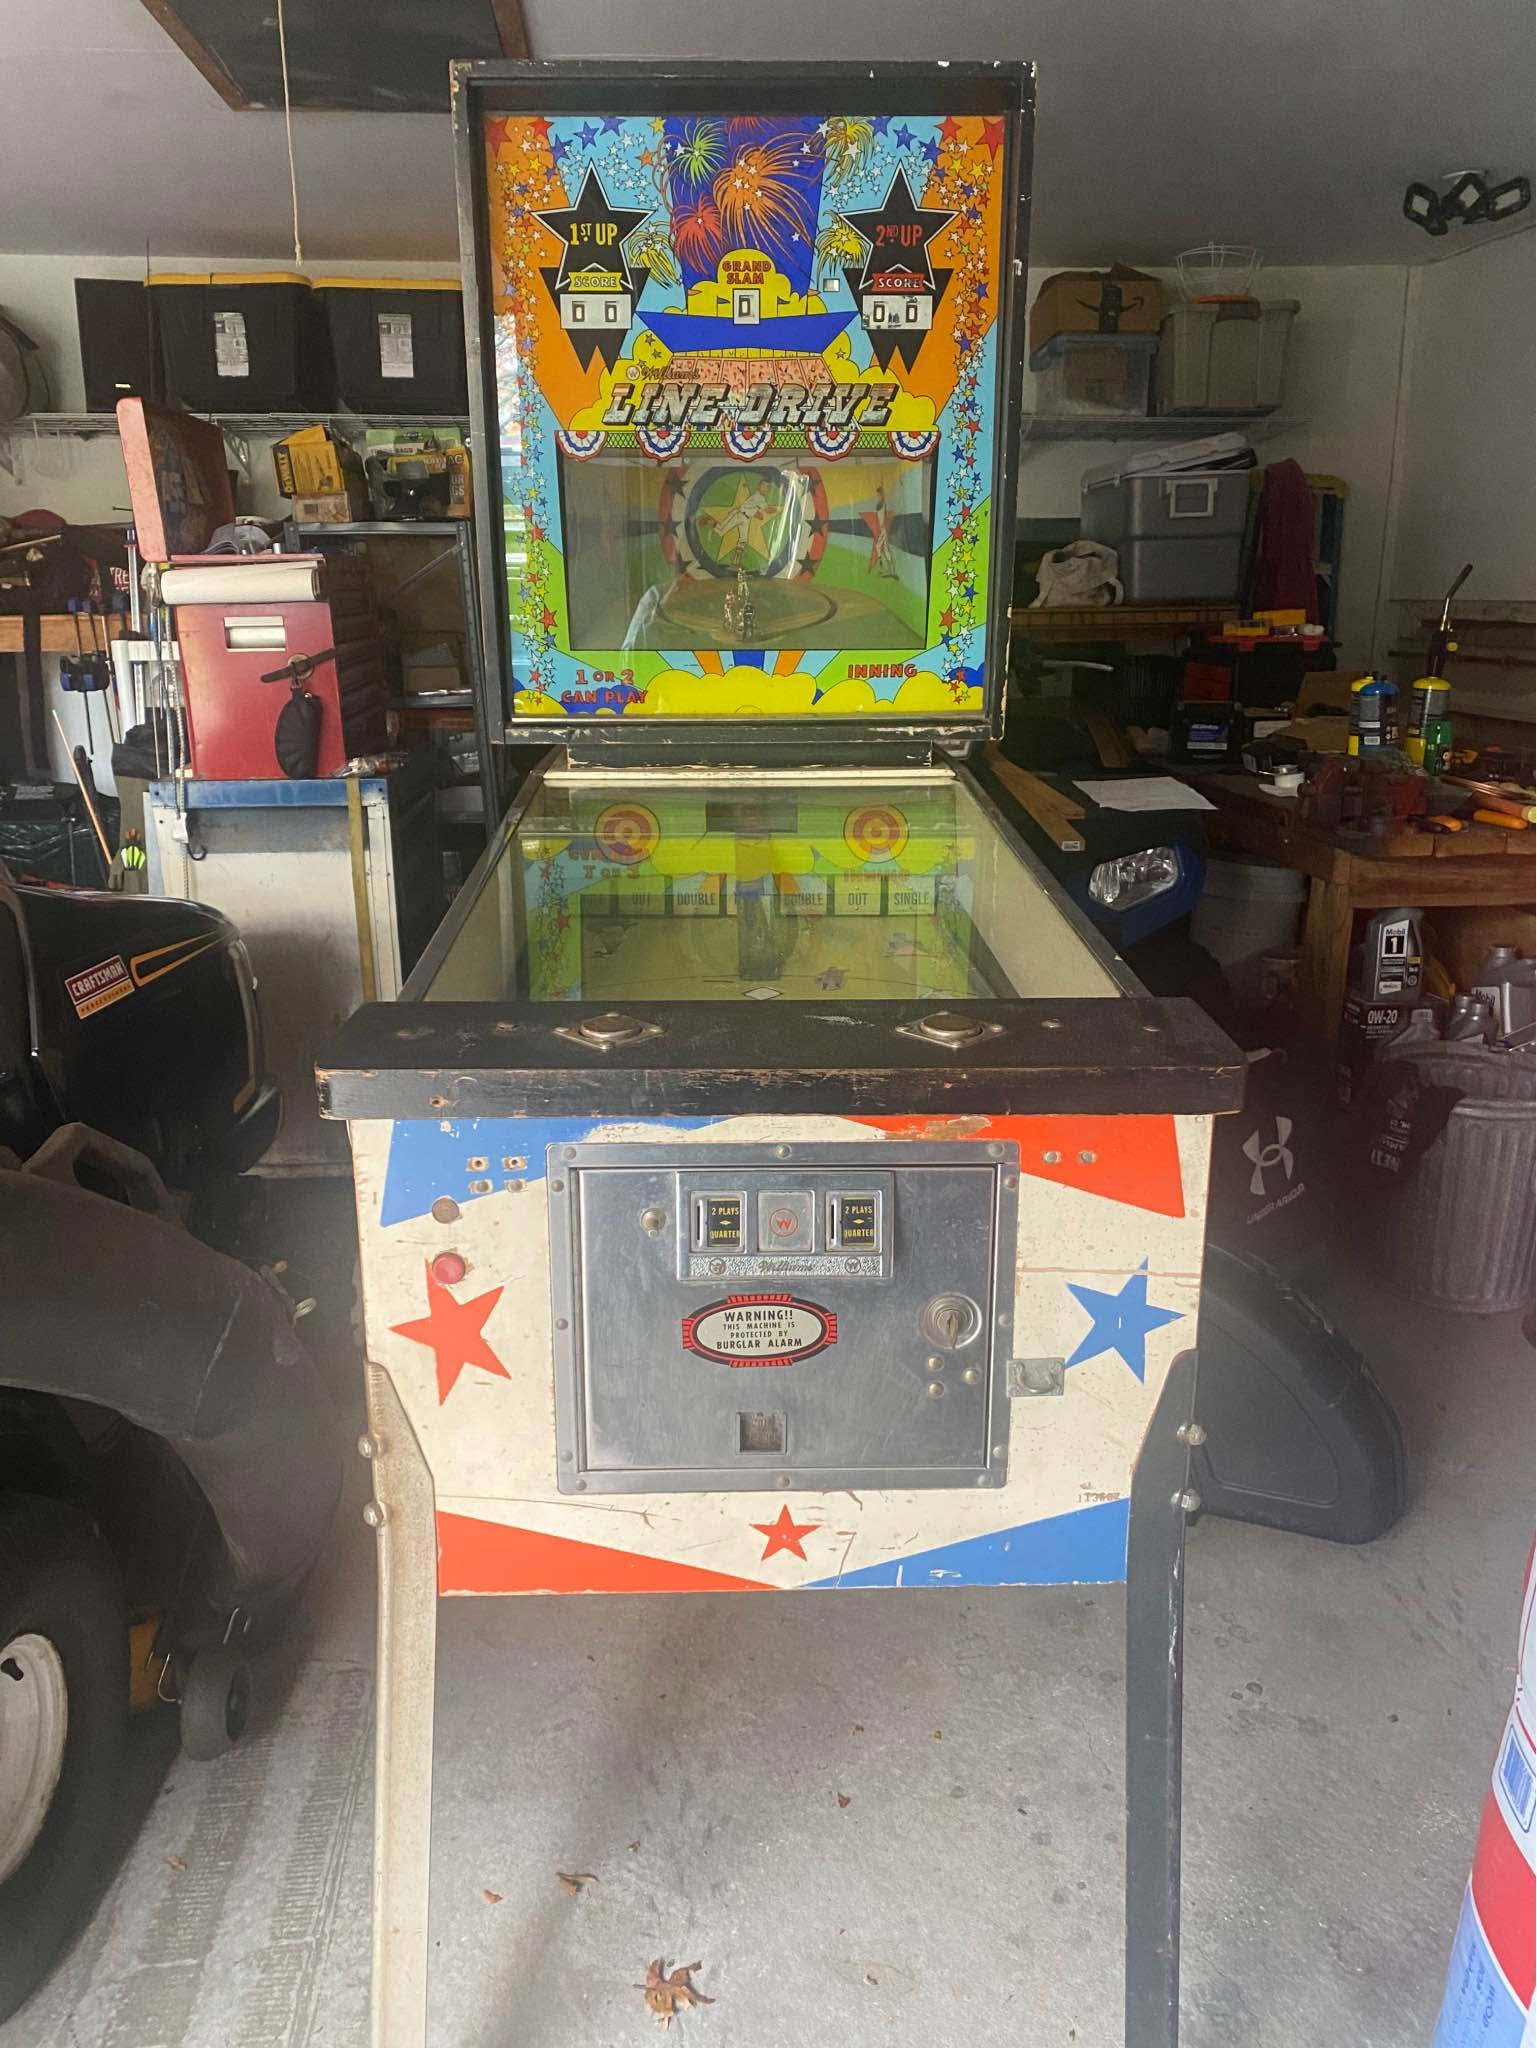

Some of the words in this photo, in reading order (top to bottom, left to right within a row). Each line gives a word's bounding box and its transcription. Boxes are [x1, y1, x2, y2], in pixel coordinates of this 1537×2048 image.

[570, 223, 592, 245] 1ST
[595, 223, 618, 245] UP
[875, 225, 898, 246] 2ND
[901, 225, 923, 246] UP
[722, 261, 772, 272] GRAND
[575, 276, 617, 287] SCORE
[726, 273, 765, 284] SLAM
[878, 278, 920, 288] SCORE
[602, 383, 731, 426] LINE
[737, 383, 900, 426] DRIVE
[576, 670, 588, 684] 1
[593, 671, 614, 682] OR
[621, 669, 634, 685] 2
[848, 663, 918, 678] INNING
[561, 690, 597, 704] CAN
[604, 690, 648, 704] PLAY
[677, 892, 716, 906] DOUBLE
[784, 892, 823, 906] DOUBLE
[848, 892, 868, 906] OUT
[894, 892, 929, 906] SINGLE
[1386, 928, 1406, 936] Mobil
[1391, 937, 1398, 953] 1
[71, 962, 124, 997] CRAFTSMAN
[1367, 1009, 1398, 1024] 0W-20
[711, 1207, 717, 1216] 2
[718, 1206, 740, 1216] PLAYS
[845, 1206, 850, 1215] 2
[851, 1205, 873, 1215] PLAYS
[710, 1228, 741, 1239] QUARTER
[844, 1227, 874, 1238] QUARTER
[724, 1309, 794, 1322] WARNING!!
[723, 1323, 740, 1331] THIS
[746, 1321, 782, 1330] MACHINE
[787, 1321, 796, 1329] IS
[730, 1331, 773, 1339] PROTECTED
[778, 1330, 789, 1338] BY
[716, 1340, 761, 1350] BURGLAR
[767, 1338, 803, 1348] ALARM
